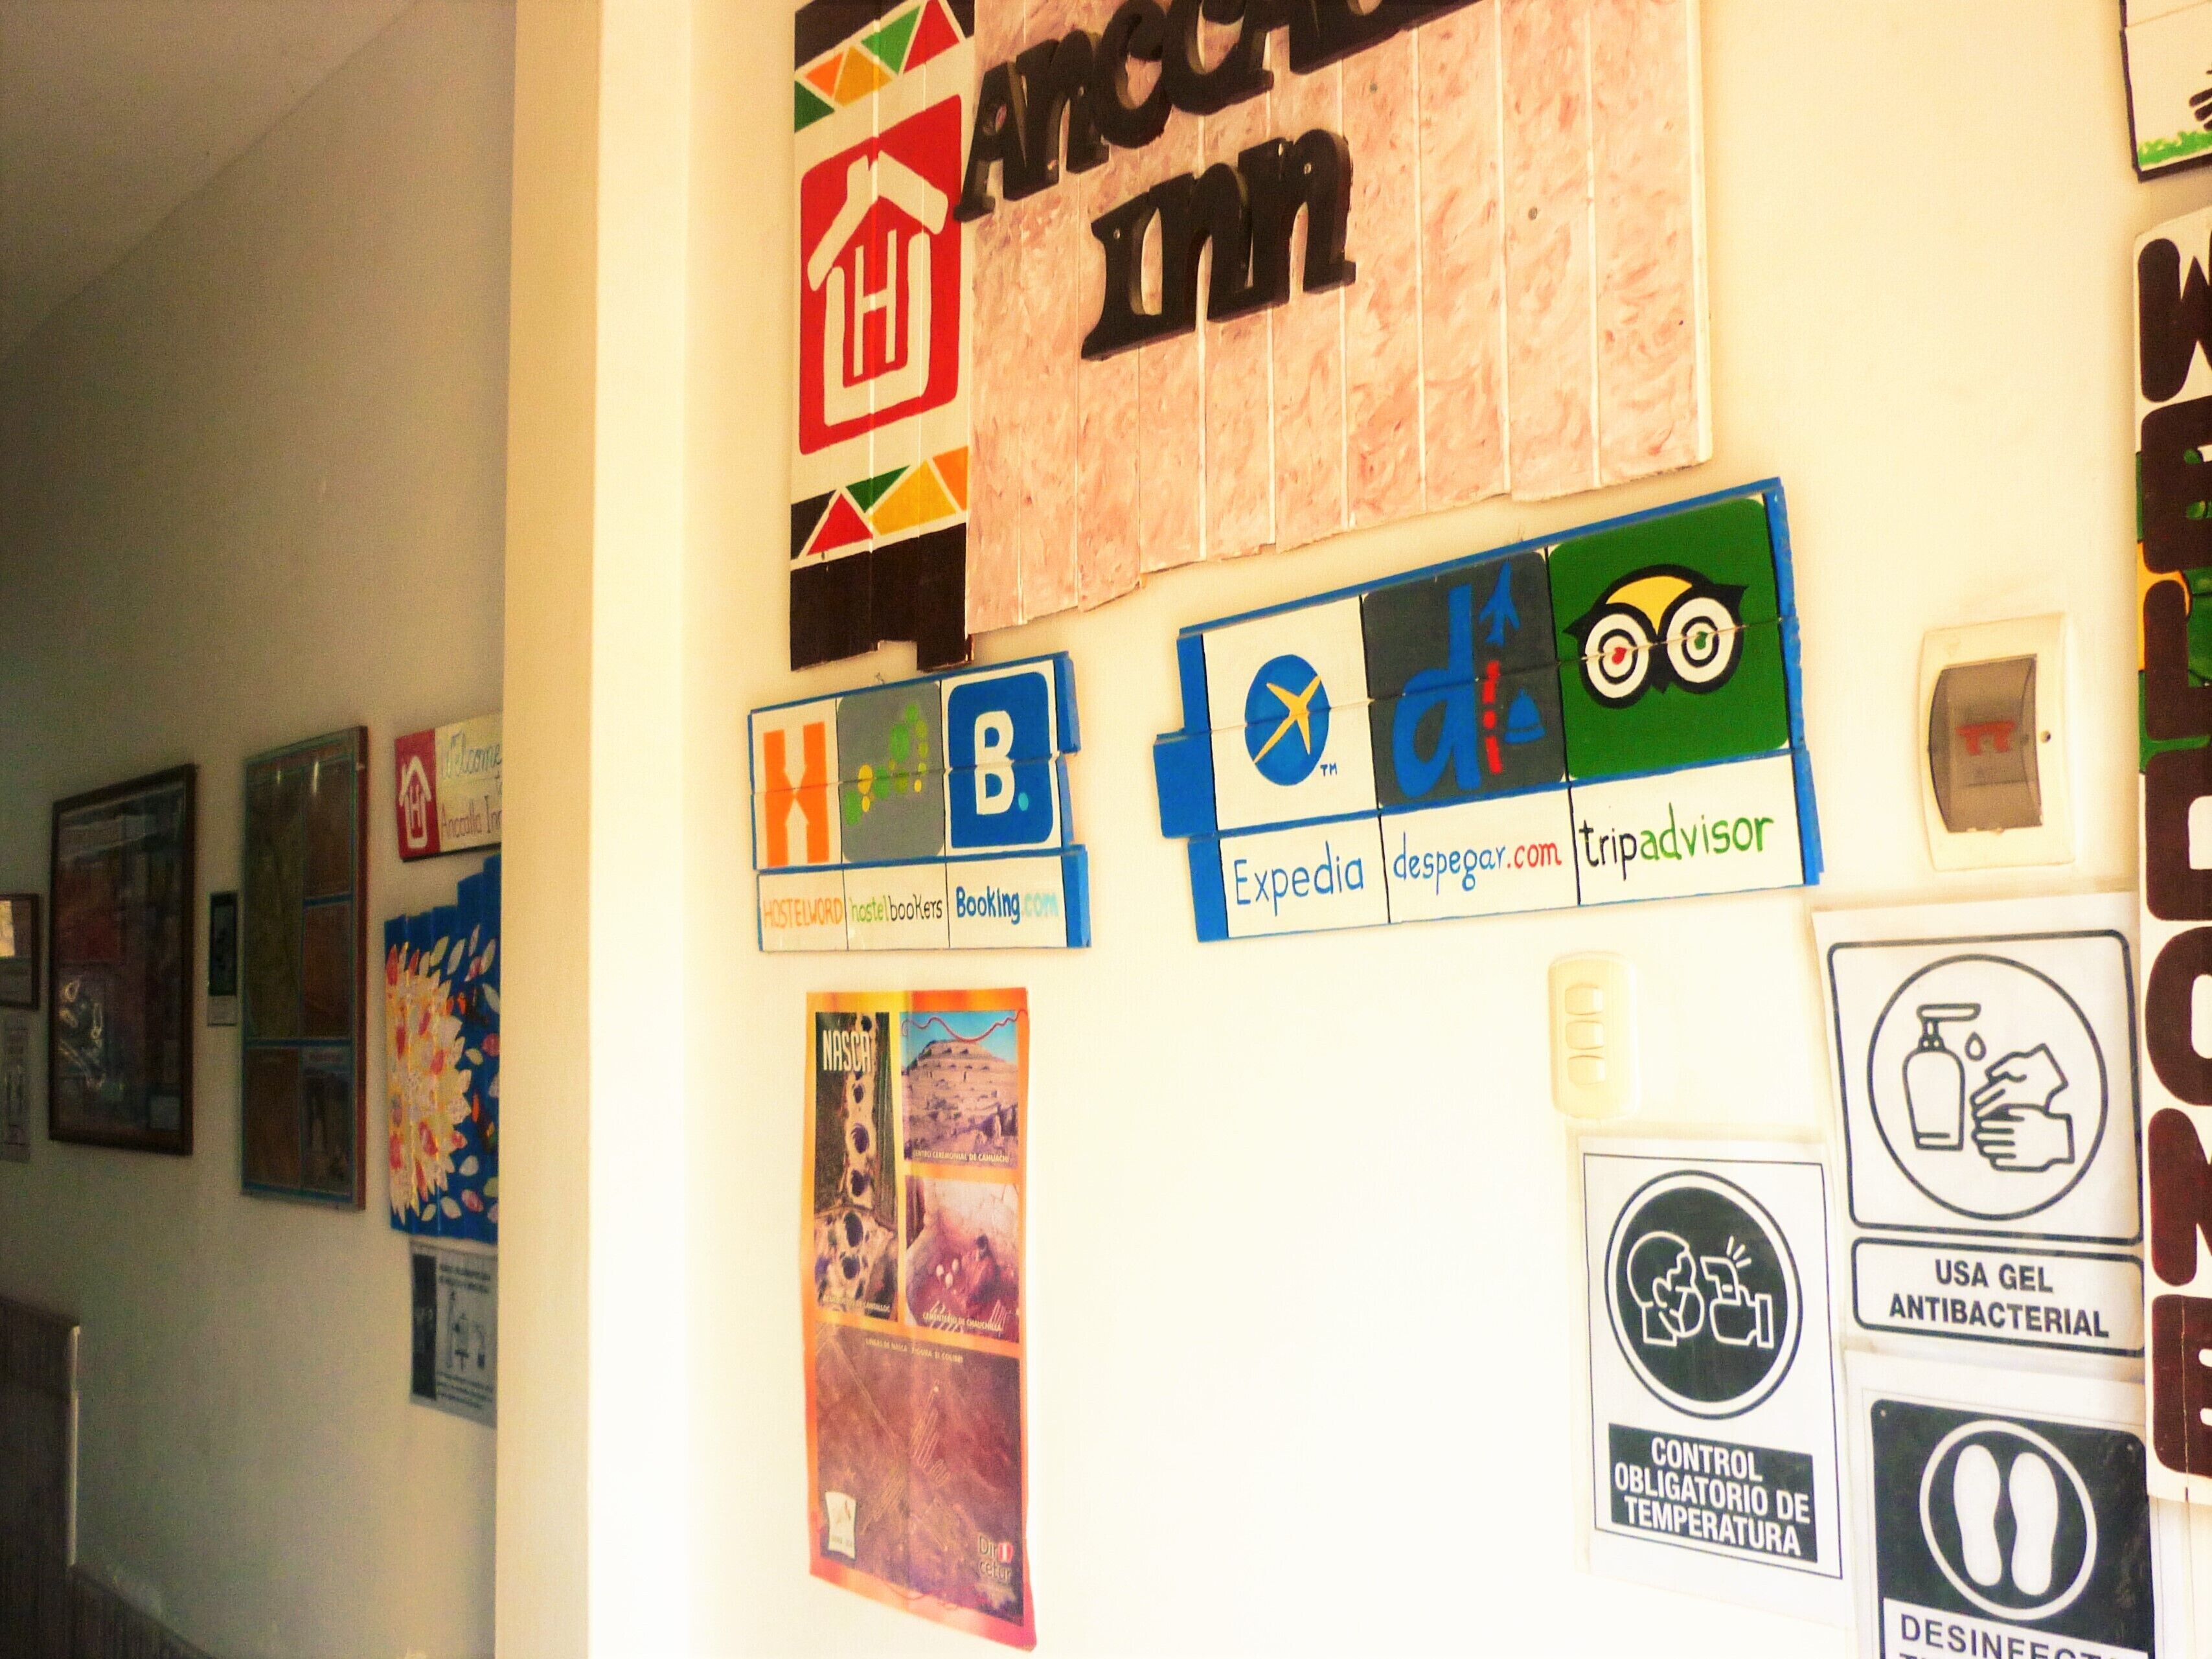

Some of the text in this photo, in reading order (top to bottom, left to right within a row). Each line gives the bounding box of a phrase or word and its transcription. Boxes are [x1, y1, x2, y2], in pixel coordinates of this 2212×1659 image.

[1080, 128, 1356, 361] Inn
[1393, 831, 1562, 896] despegar.com
[1579, 802, 1774, 880] tripadvisor
[1234, 840, 1363, 916] Expedia
[822, 1029, 872, 1073] NASCA
[1935, 1259, 2053, 1293] USA GEL
[1889, 1293, 2109, 1338] ANTIBACTERIAL
[1651, 1436, 1763, 1482] CONTROL
[1614, 1462, 1811, 1523] OBLIGATORIO DE
[1624, 1496, 1802, 1556] TEMPERATURA
[1900, 1613, 2119, 1659] DESINFE
